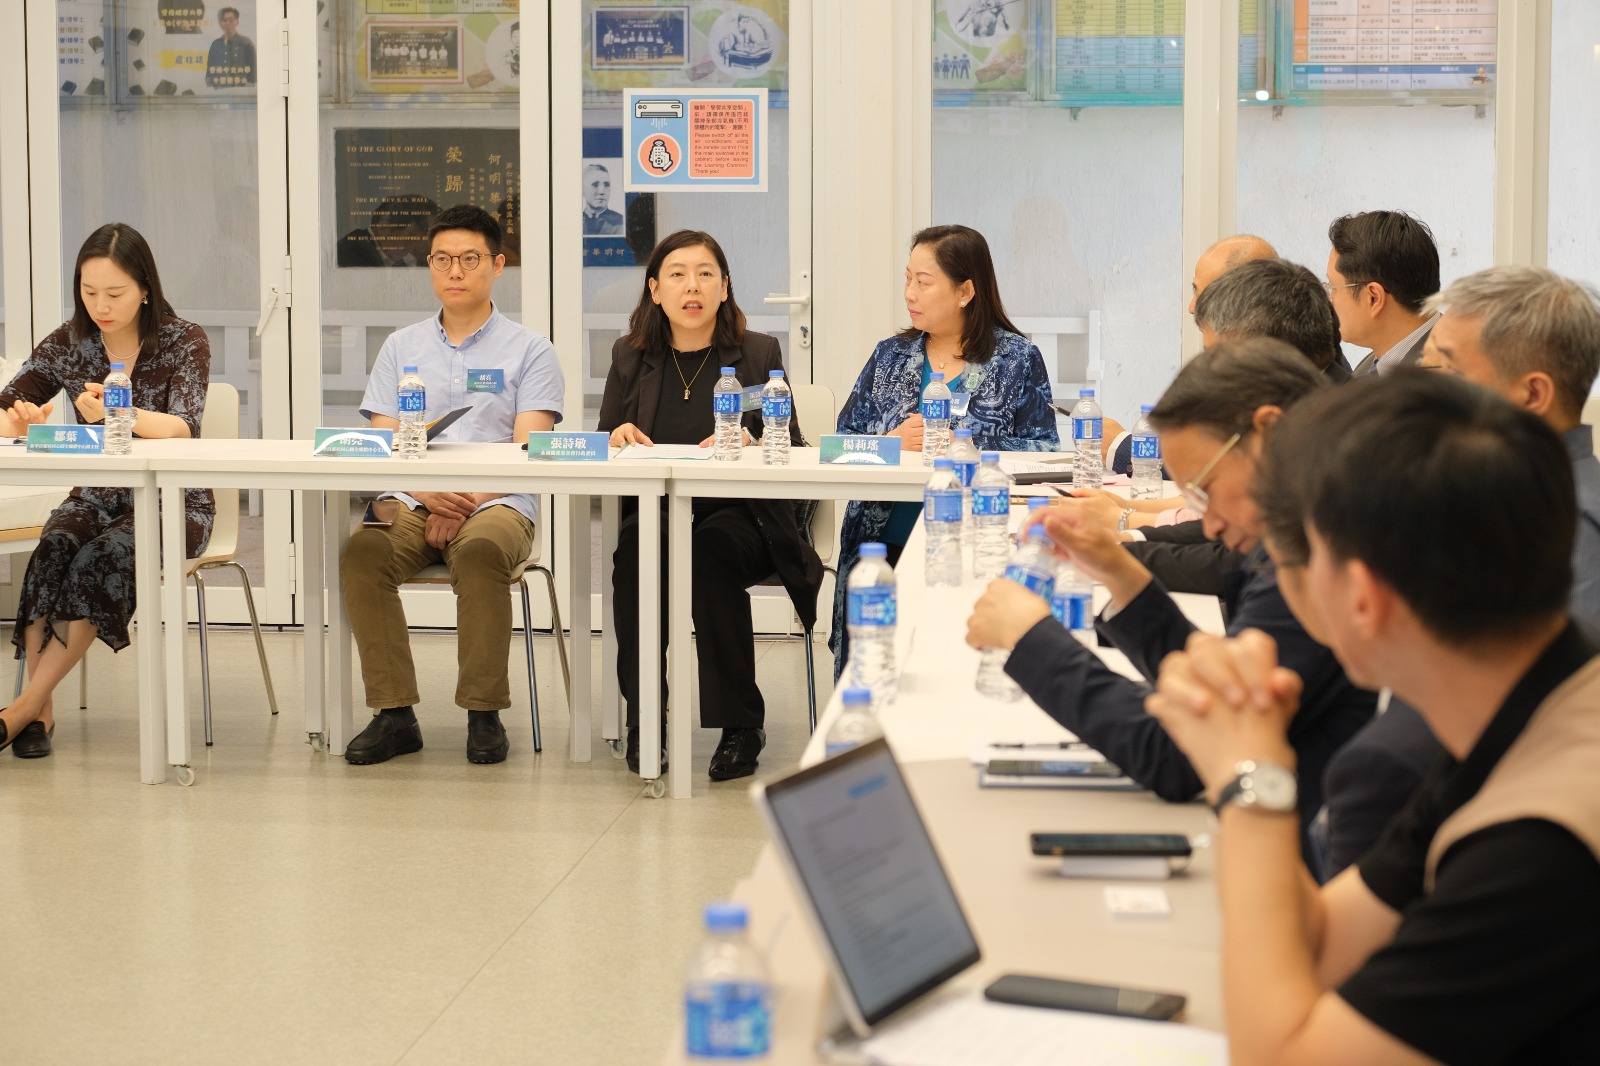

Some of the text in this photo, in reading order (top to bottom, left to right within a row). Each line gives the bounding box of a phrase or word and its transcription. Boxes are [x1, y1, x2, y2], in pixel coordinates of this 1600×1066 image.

[346, 145, 433, 153] TO THE GLORY OF GOD
[550, 437, 587, 449] 張詩敏
